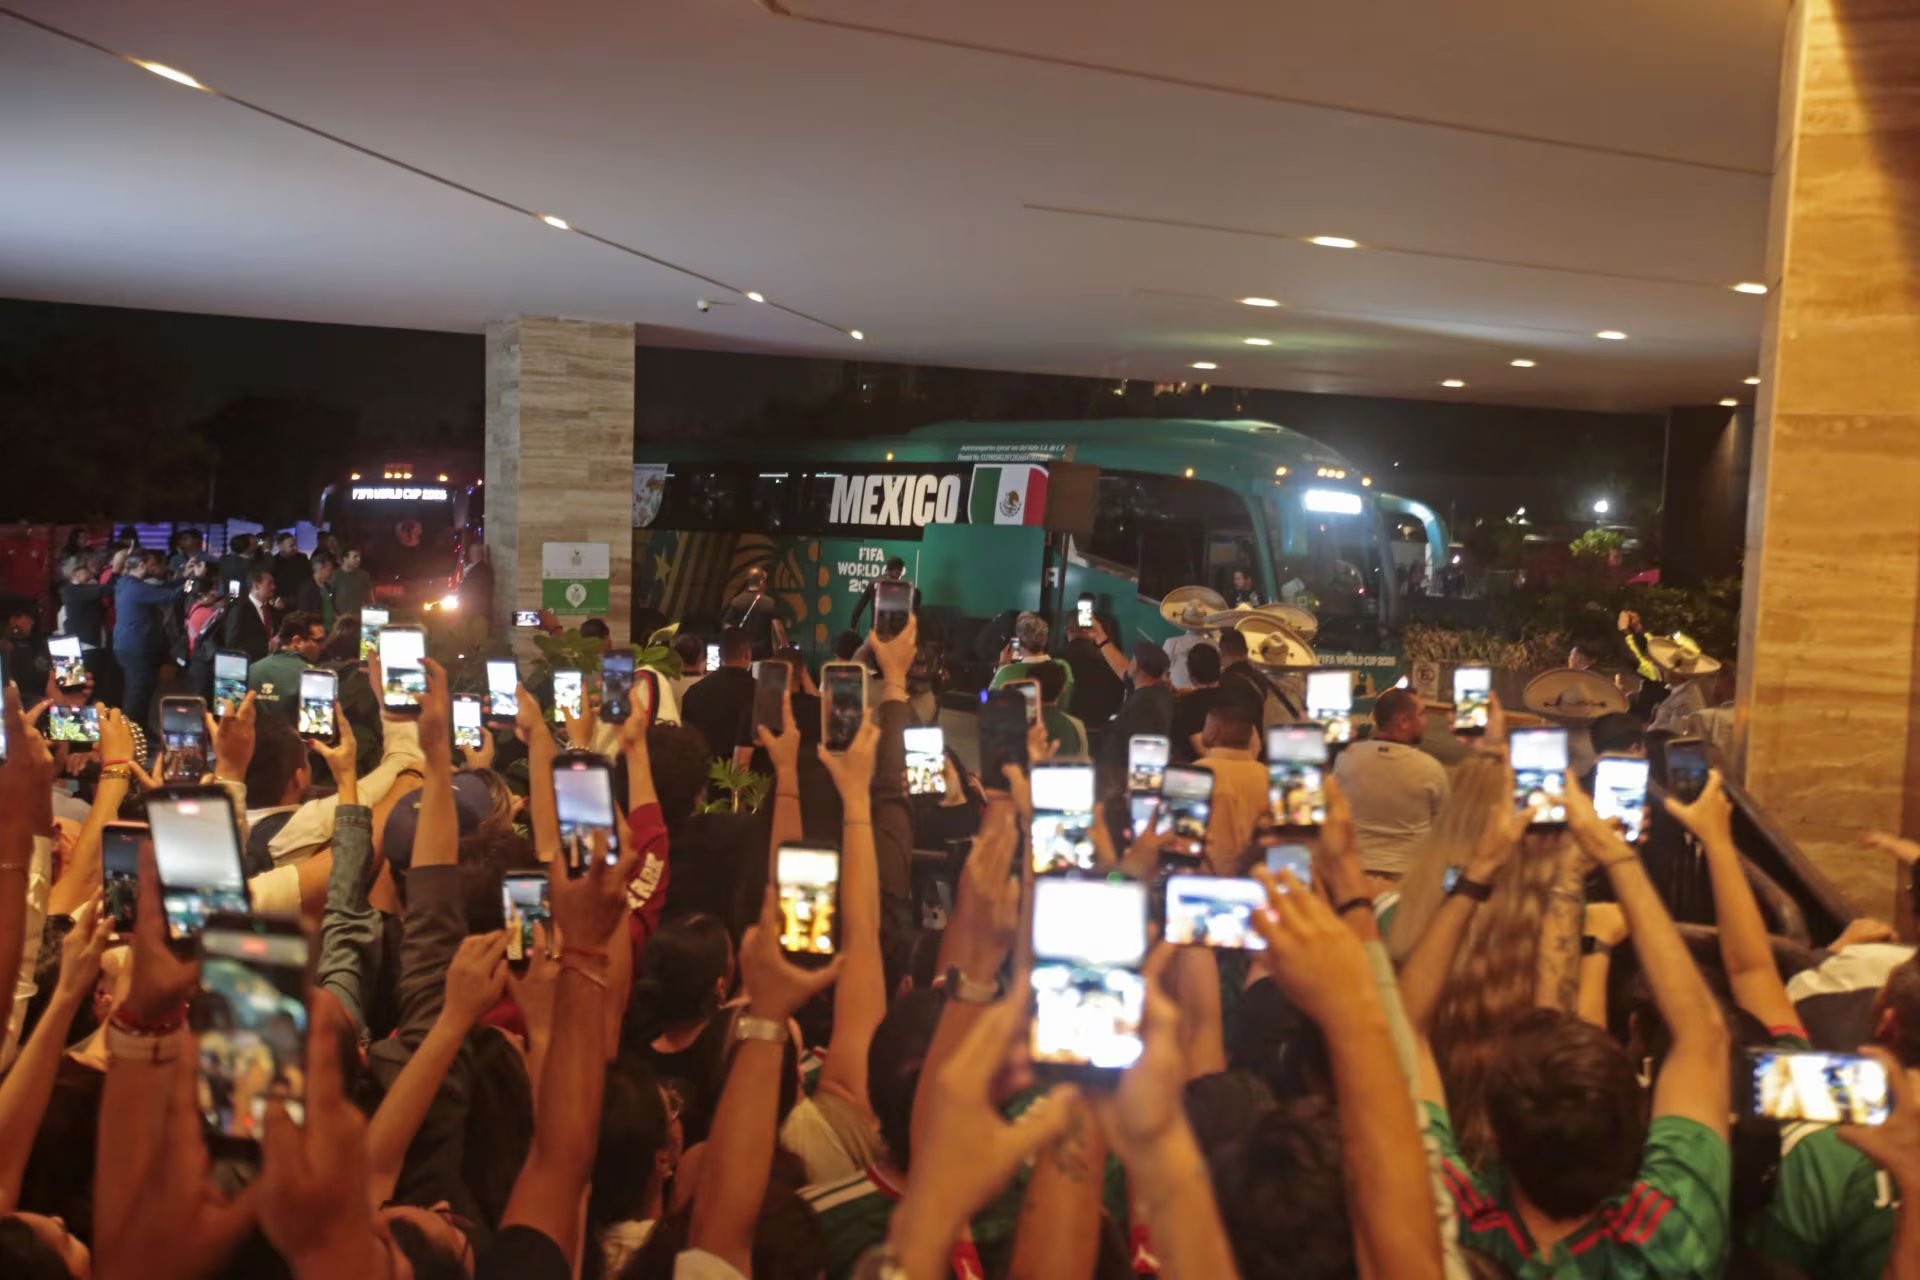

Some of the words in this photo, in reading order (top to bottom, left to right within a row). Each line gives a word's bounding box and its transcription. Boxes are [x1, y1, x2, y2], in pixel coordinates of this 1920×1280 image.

[352, 488, 373, 500] FIFA
[374, 488, 402, 500] WORLD
[403, 488, 422, 500] CUP
[829, 474, 961, 526] MEXICO
[858, 547, 885, 562] FIFA
[837, 561, 880, 577] WORLD
[1336, 656, 1363, 665] WORLD
[1364, 656, 1377, 666] CUP
